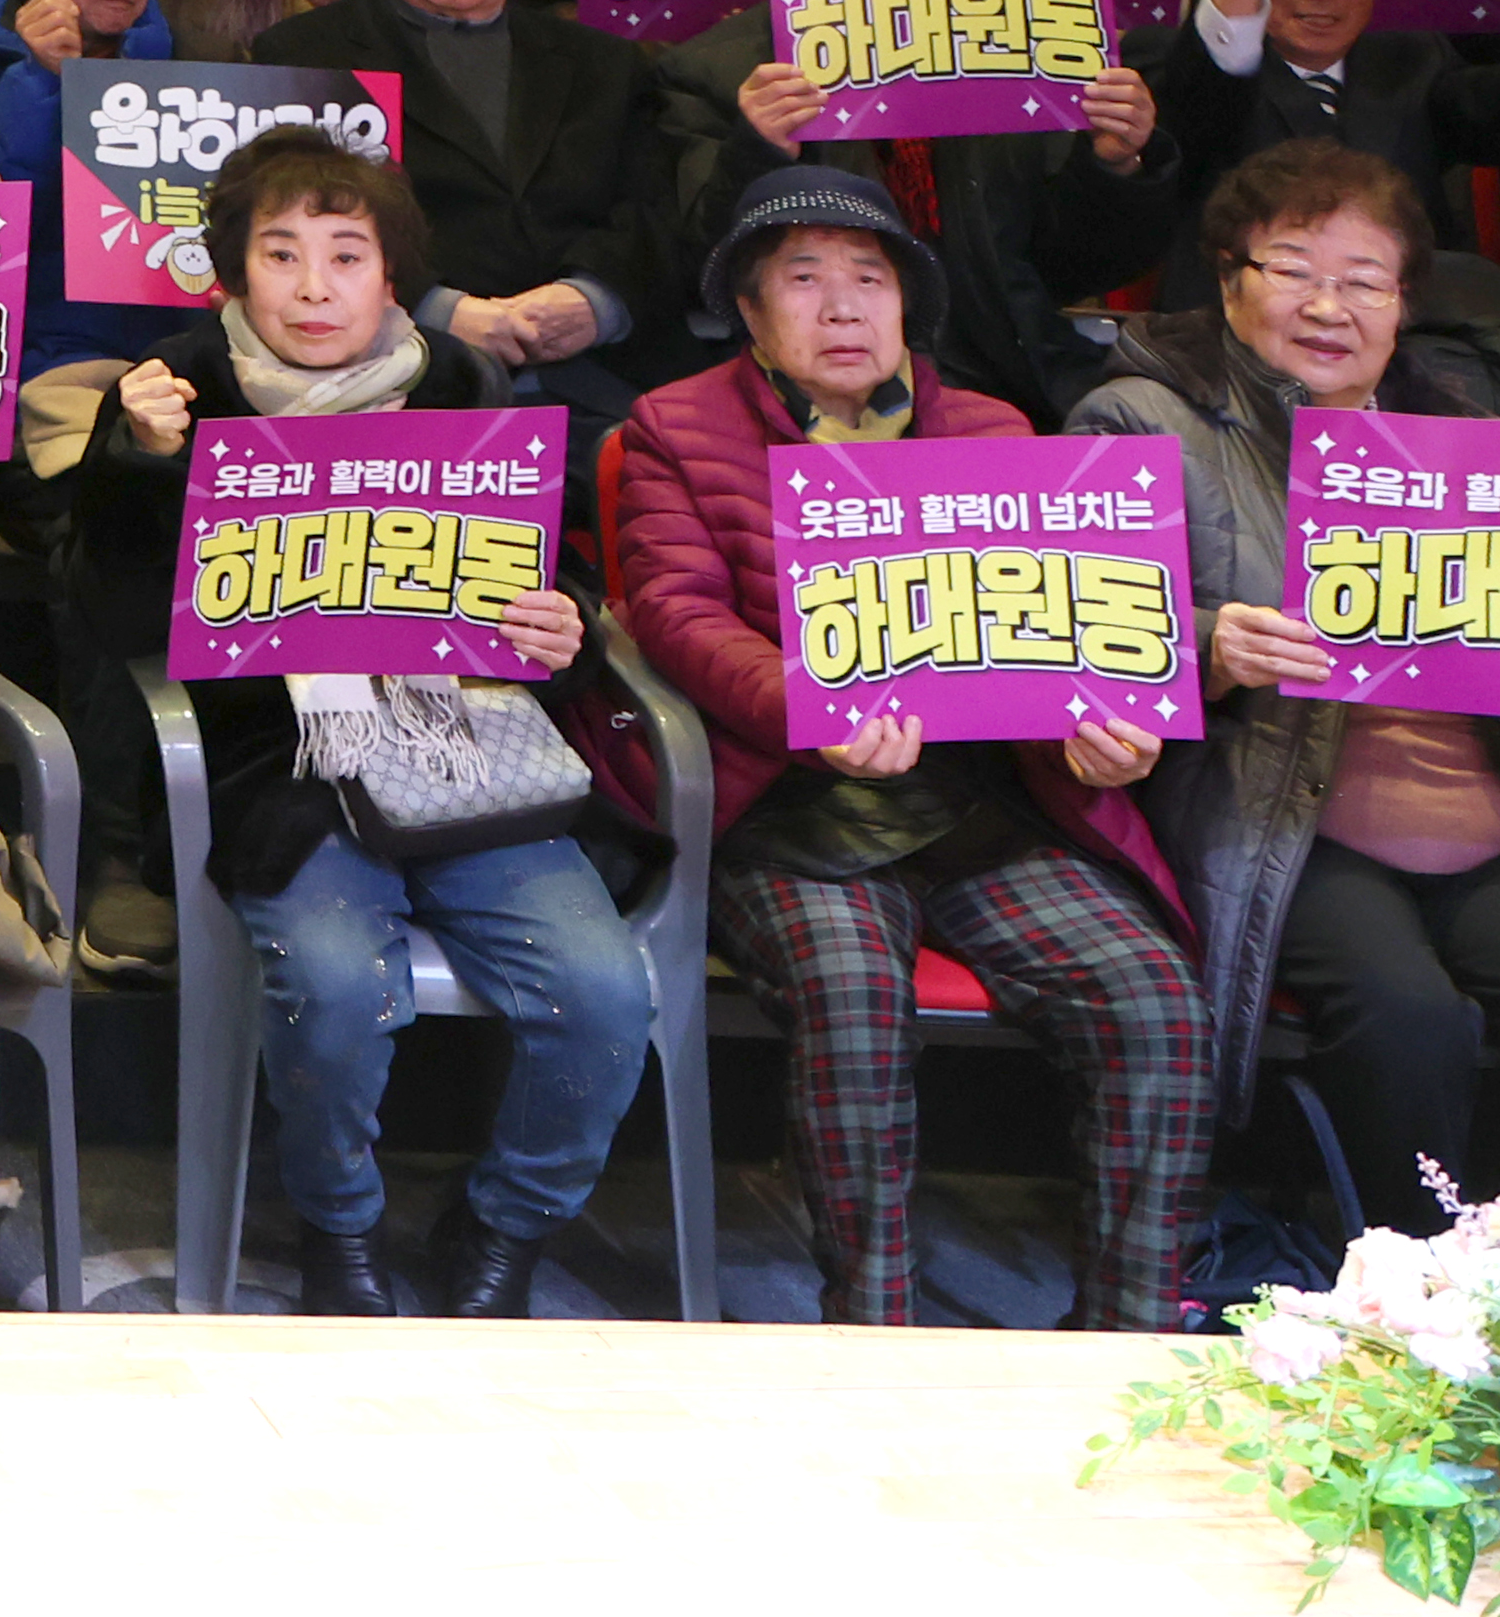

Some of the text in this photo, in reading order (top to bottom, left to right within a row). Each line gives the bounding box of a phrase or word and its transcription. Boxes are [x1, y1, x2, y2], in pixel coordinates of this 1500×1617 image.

[213, 457, 542, 501] 웃음과 활력이 넘치는
[798, 493, 1155, 541] 웃음과 활력이 넘치는
[191, 508, 548, 630] 하대원동
[792, 545, 1178, 688] 하대원동
